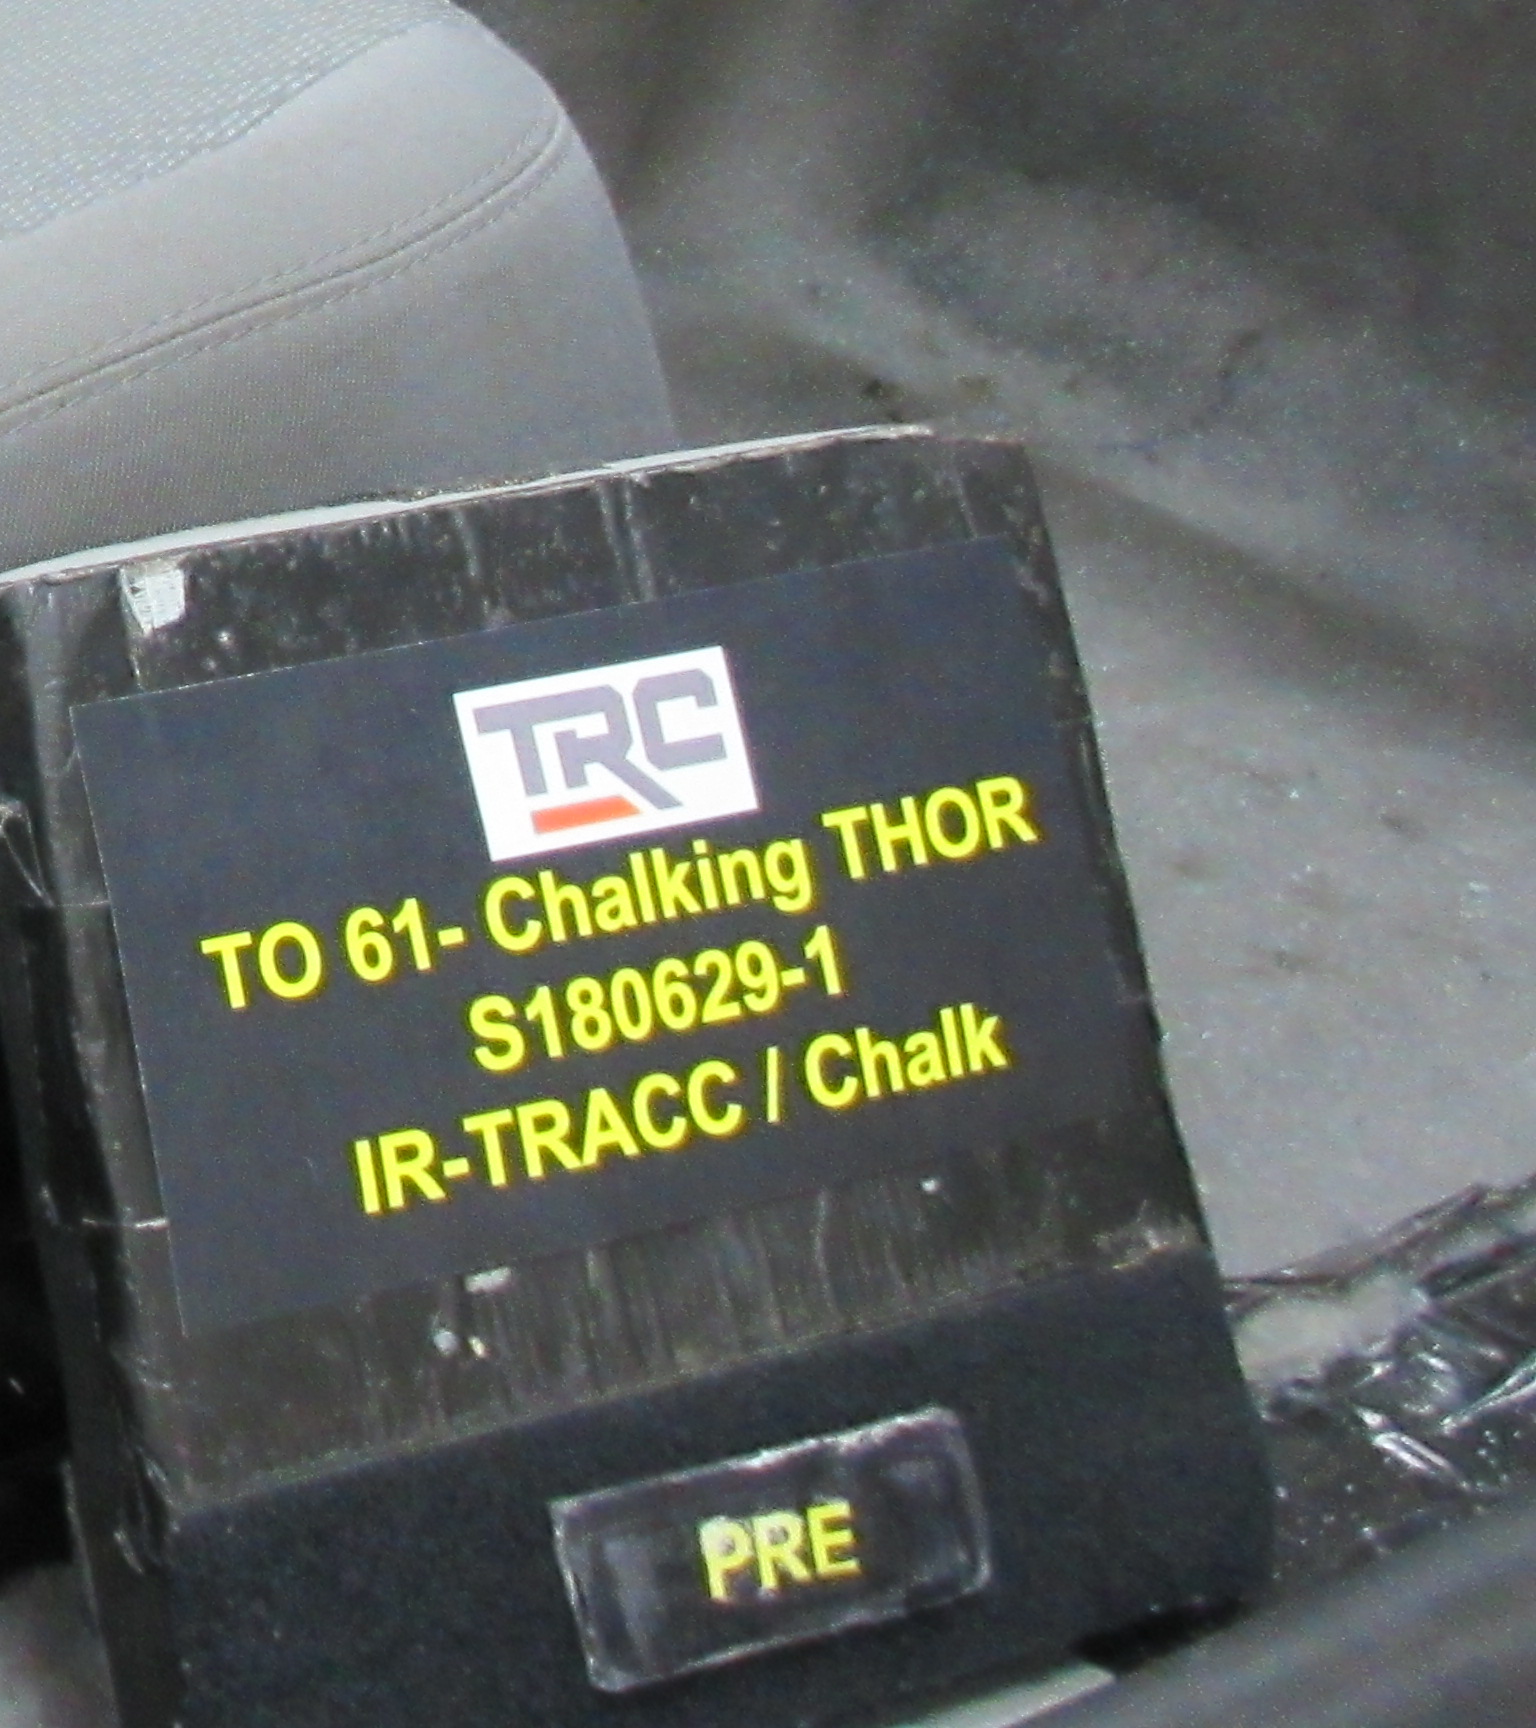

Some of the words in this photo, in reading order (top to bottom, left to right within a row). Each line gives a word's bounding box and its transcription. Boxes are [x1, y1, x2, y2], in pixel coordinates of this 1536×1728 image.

[472, 668, 728, 812] TRC
[200, 921, 321, 1010] TO
[343, 896, 464, 983] 61-
[483, 835, 812, 956] Chalking
[820, 774, 1037, 879] THOR
[466, 923, 843, 1073] S180629-1
[351, 1058, 744, 1215] IR-TRACC
[764, 1046, 782, 1125] /
[802, 1002, 1009, 1110] Chalk
[699, 1496, 862, 1602] PRE
